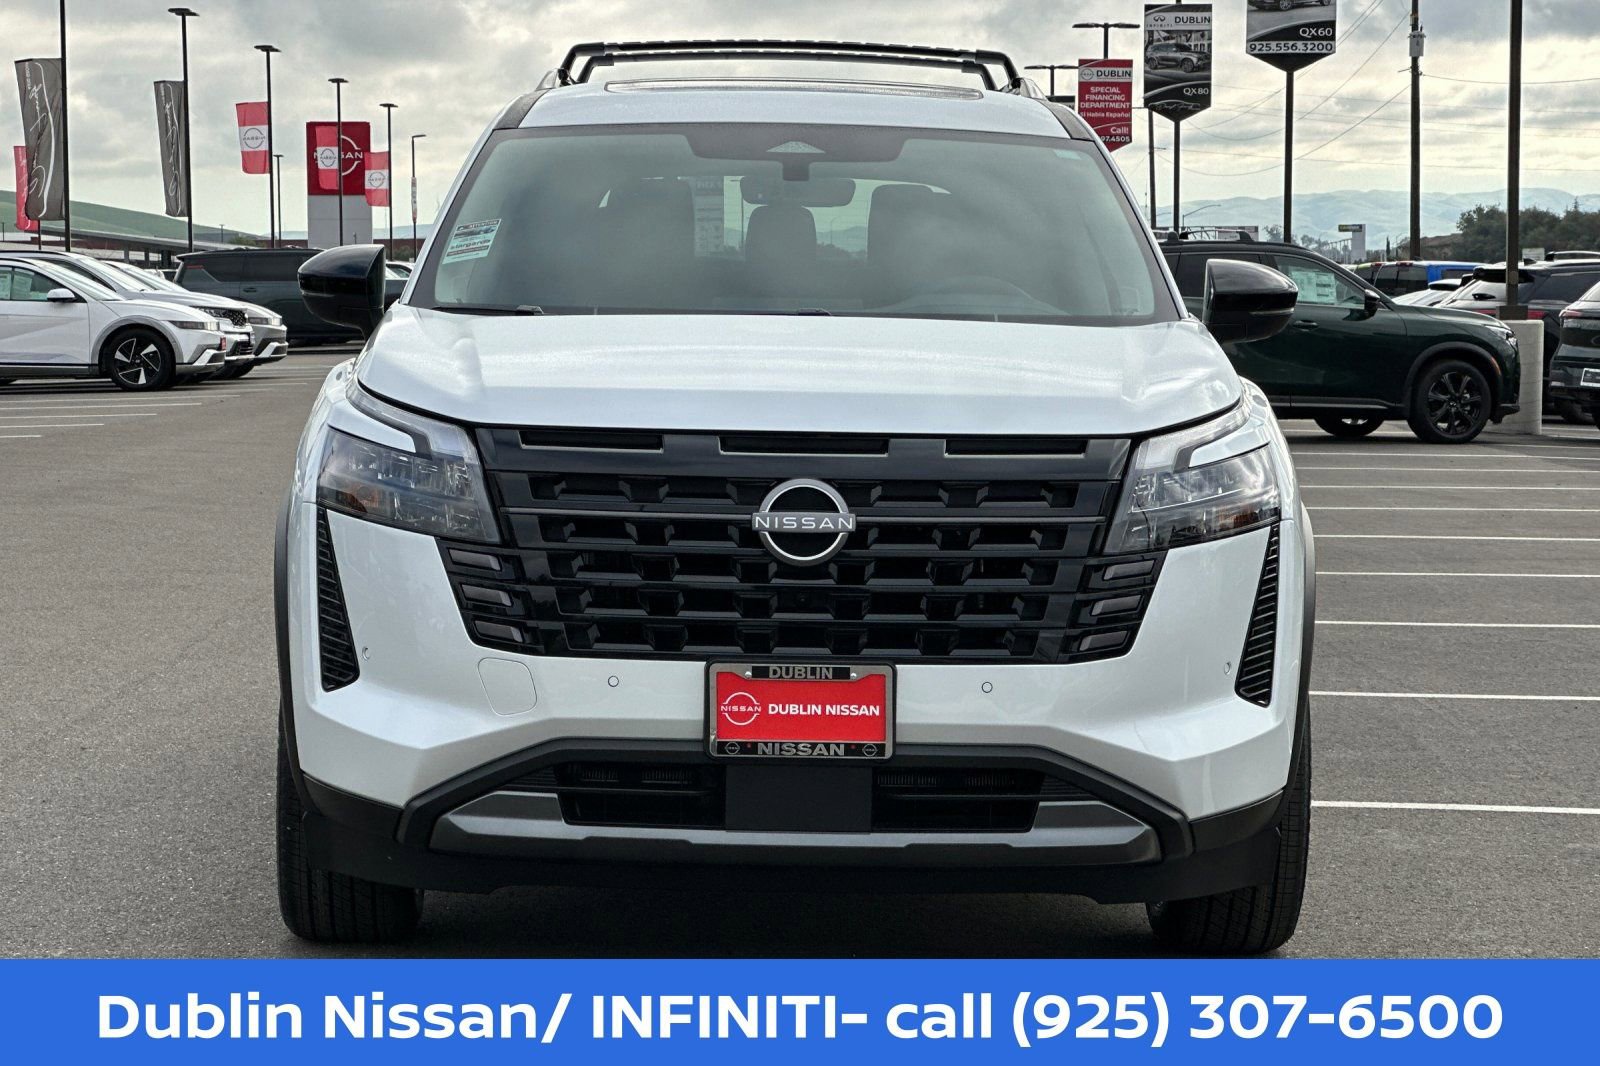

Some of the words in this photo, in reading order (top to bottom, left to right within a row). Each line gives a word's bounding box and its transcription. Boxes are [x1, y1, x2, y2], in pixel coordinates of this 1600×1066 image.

[1174, 16, 1210, 24] DUBLIN
[1299, 27, 1333, 38] QX60
[1249, 42, 1333, 52] 925.556.3200
[1183, 87, 1209, 96] QX80
[1110, 126, 1129, 134] Call!
[313, 151, 363, 159] NSAN
[755, 516, 853, 530] NISSAN
[768, 666, 833, 680] DUBLIN
[768, 703, 822, 716] DUBLIN
[825, 704, 880, 716] NISSAN
[757, 742, 845, 756] NISSAN
